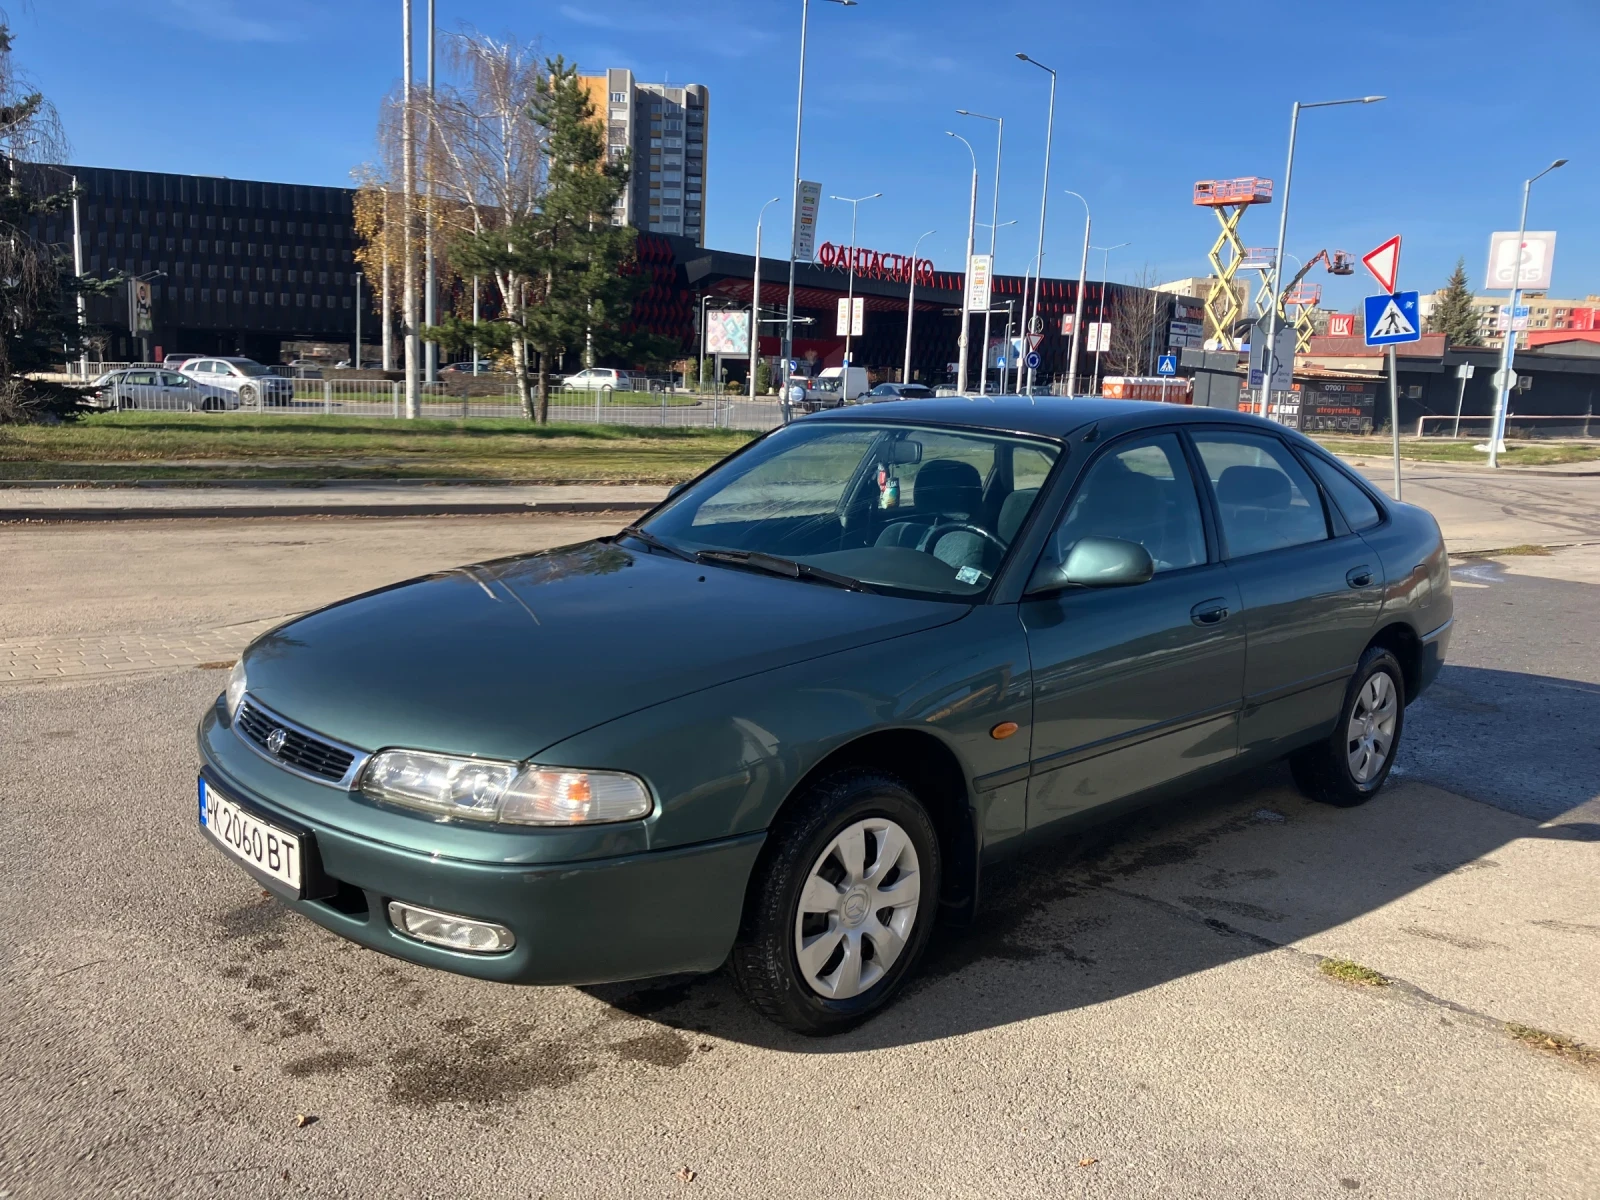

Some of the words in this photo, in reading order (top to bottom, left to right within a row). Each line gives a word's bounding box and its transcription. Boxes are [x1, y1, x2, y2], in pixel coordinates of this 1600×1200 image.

[819, 242, 934, 280] ФАНТАСТИКО
[206, 791, 221, 835] PK
[223, 807, 263, 862] 2060
[267, 833, 295, 878] BT
